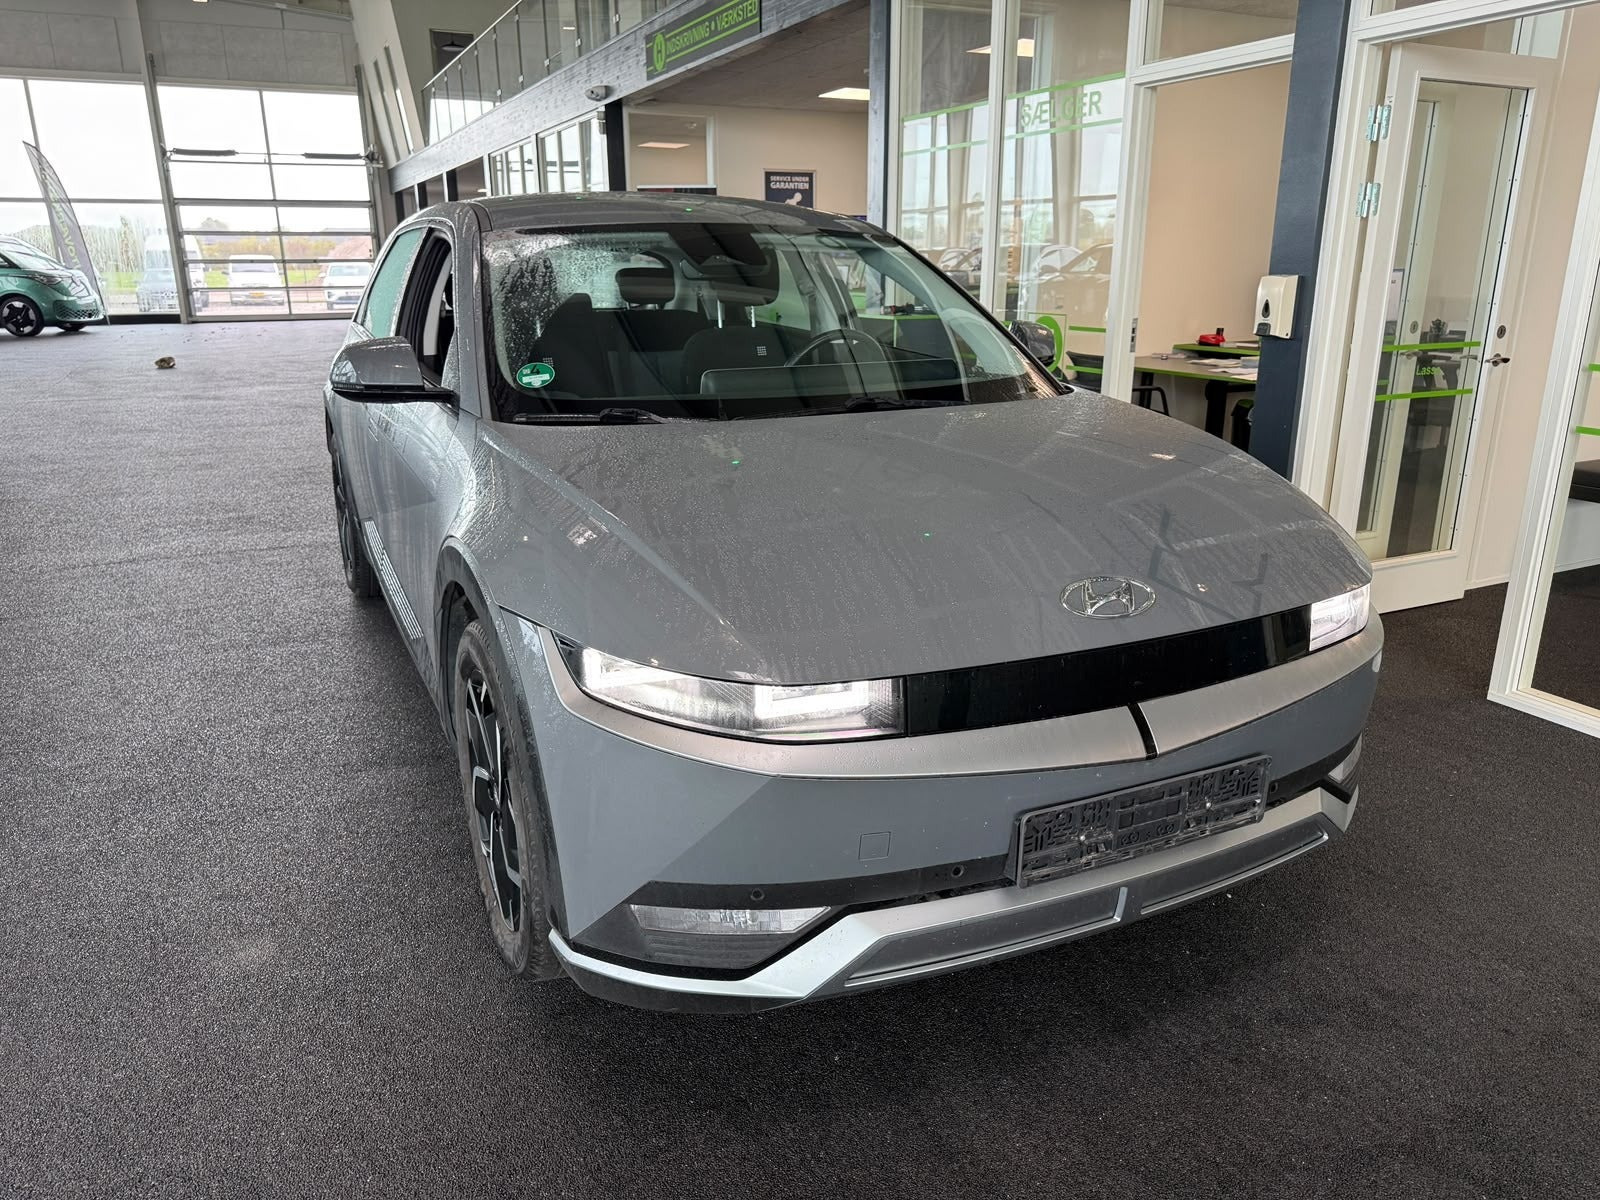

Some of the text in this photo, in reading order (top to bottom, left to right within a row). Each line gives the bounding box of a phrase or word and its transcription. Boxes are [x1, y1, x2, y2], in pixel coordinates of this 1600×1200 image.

[716, 0, 758, 31] VÆRKSTED
[1020, 90, 1102, 127] SÆLGER
[770, 182, 809, 190] GARANTIEN
[530, 364, 541, 375] 4
